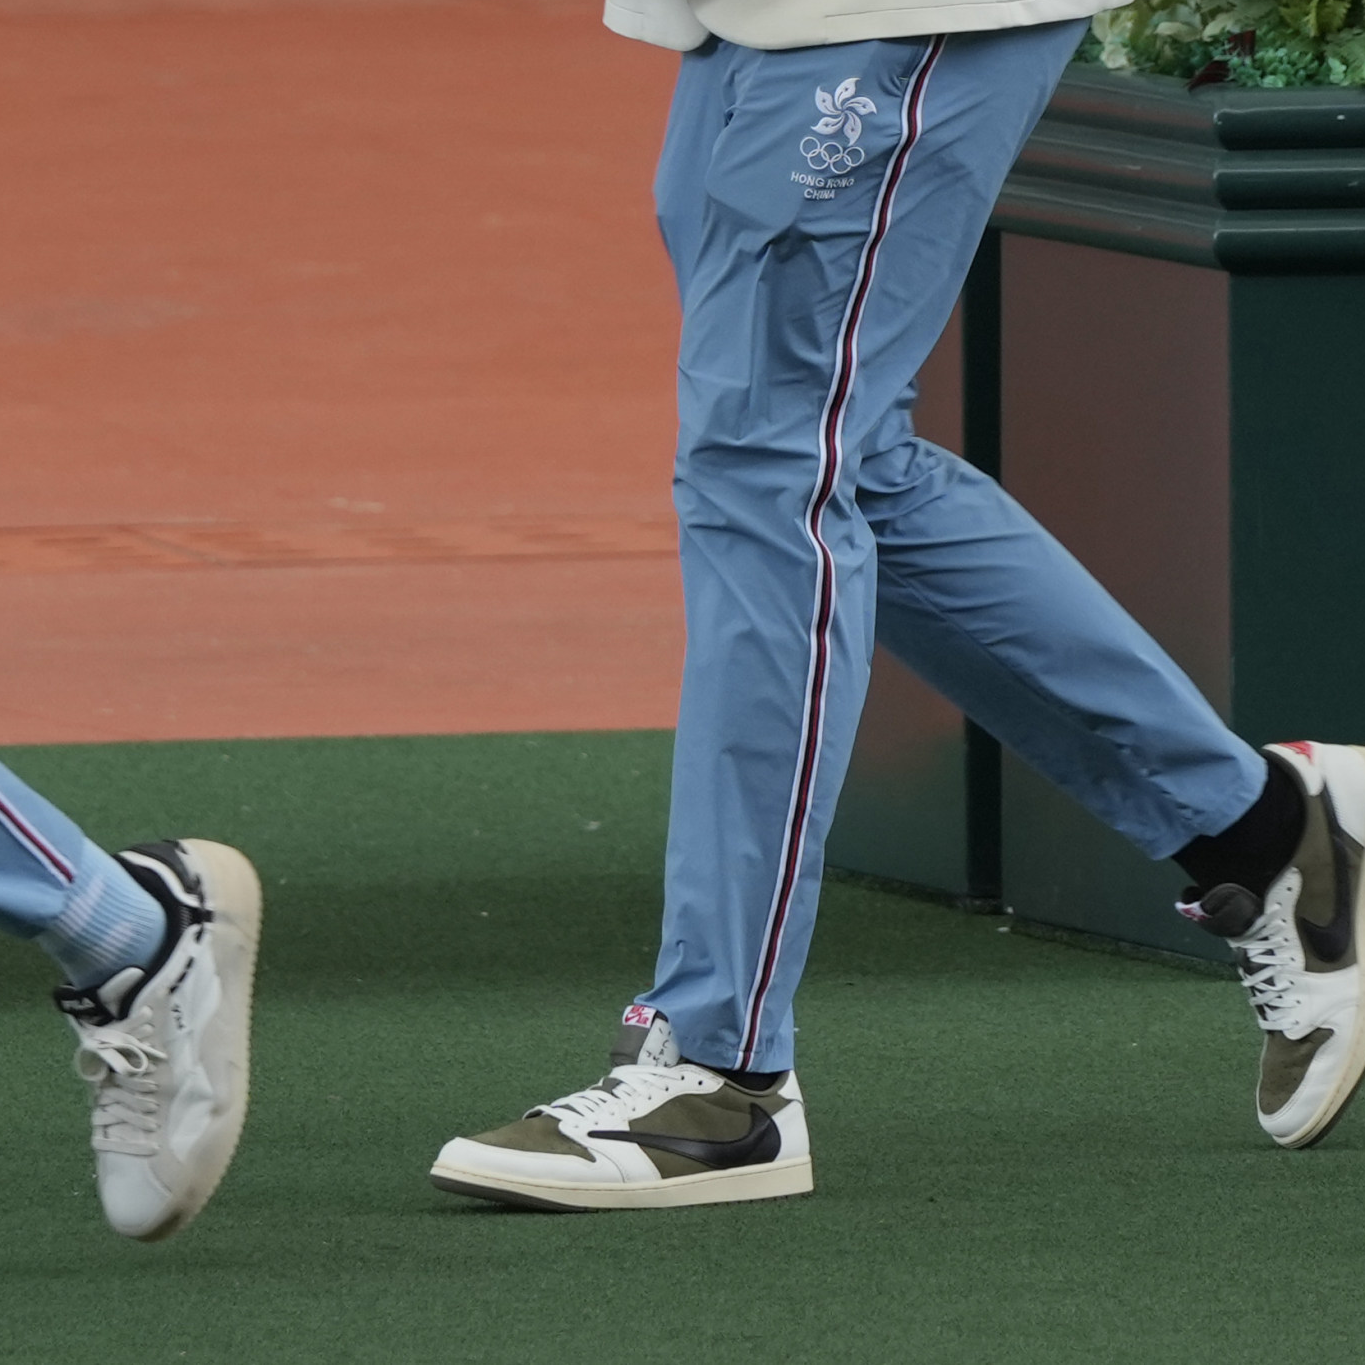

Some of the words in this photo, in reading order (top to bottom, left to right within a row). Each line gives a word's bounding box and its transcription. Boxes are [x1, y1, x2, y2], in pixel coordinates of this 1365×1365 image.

[790, 171, 825, 187] HONG
[825, 178, 854, 188] KONG
[803, 188, 835, 200] CHINA
